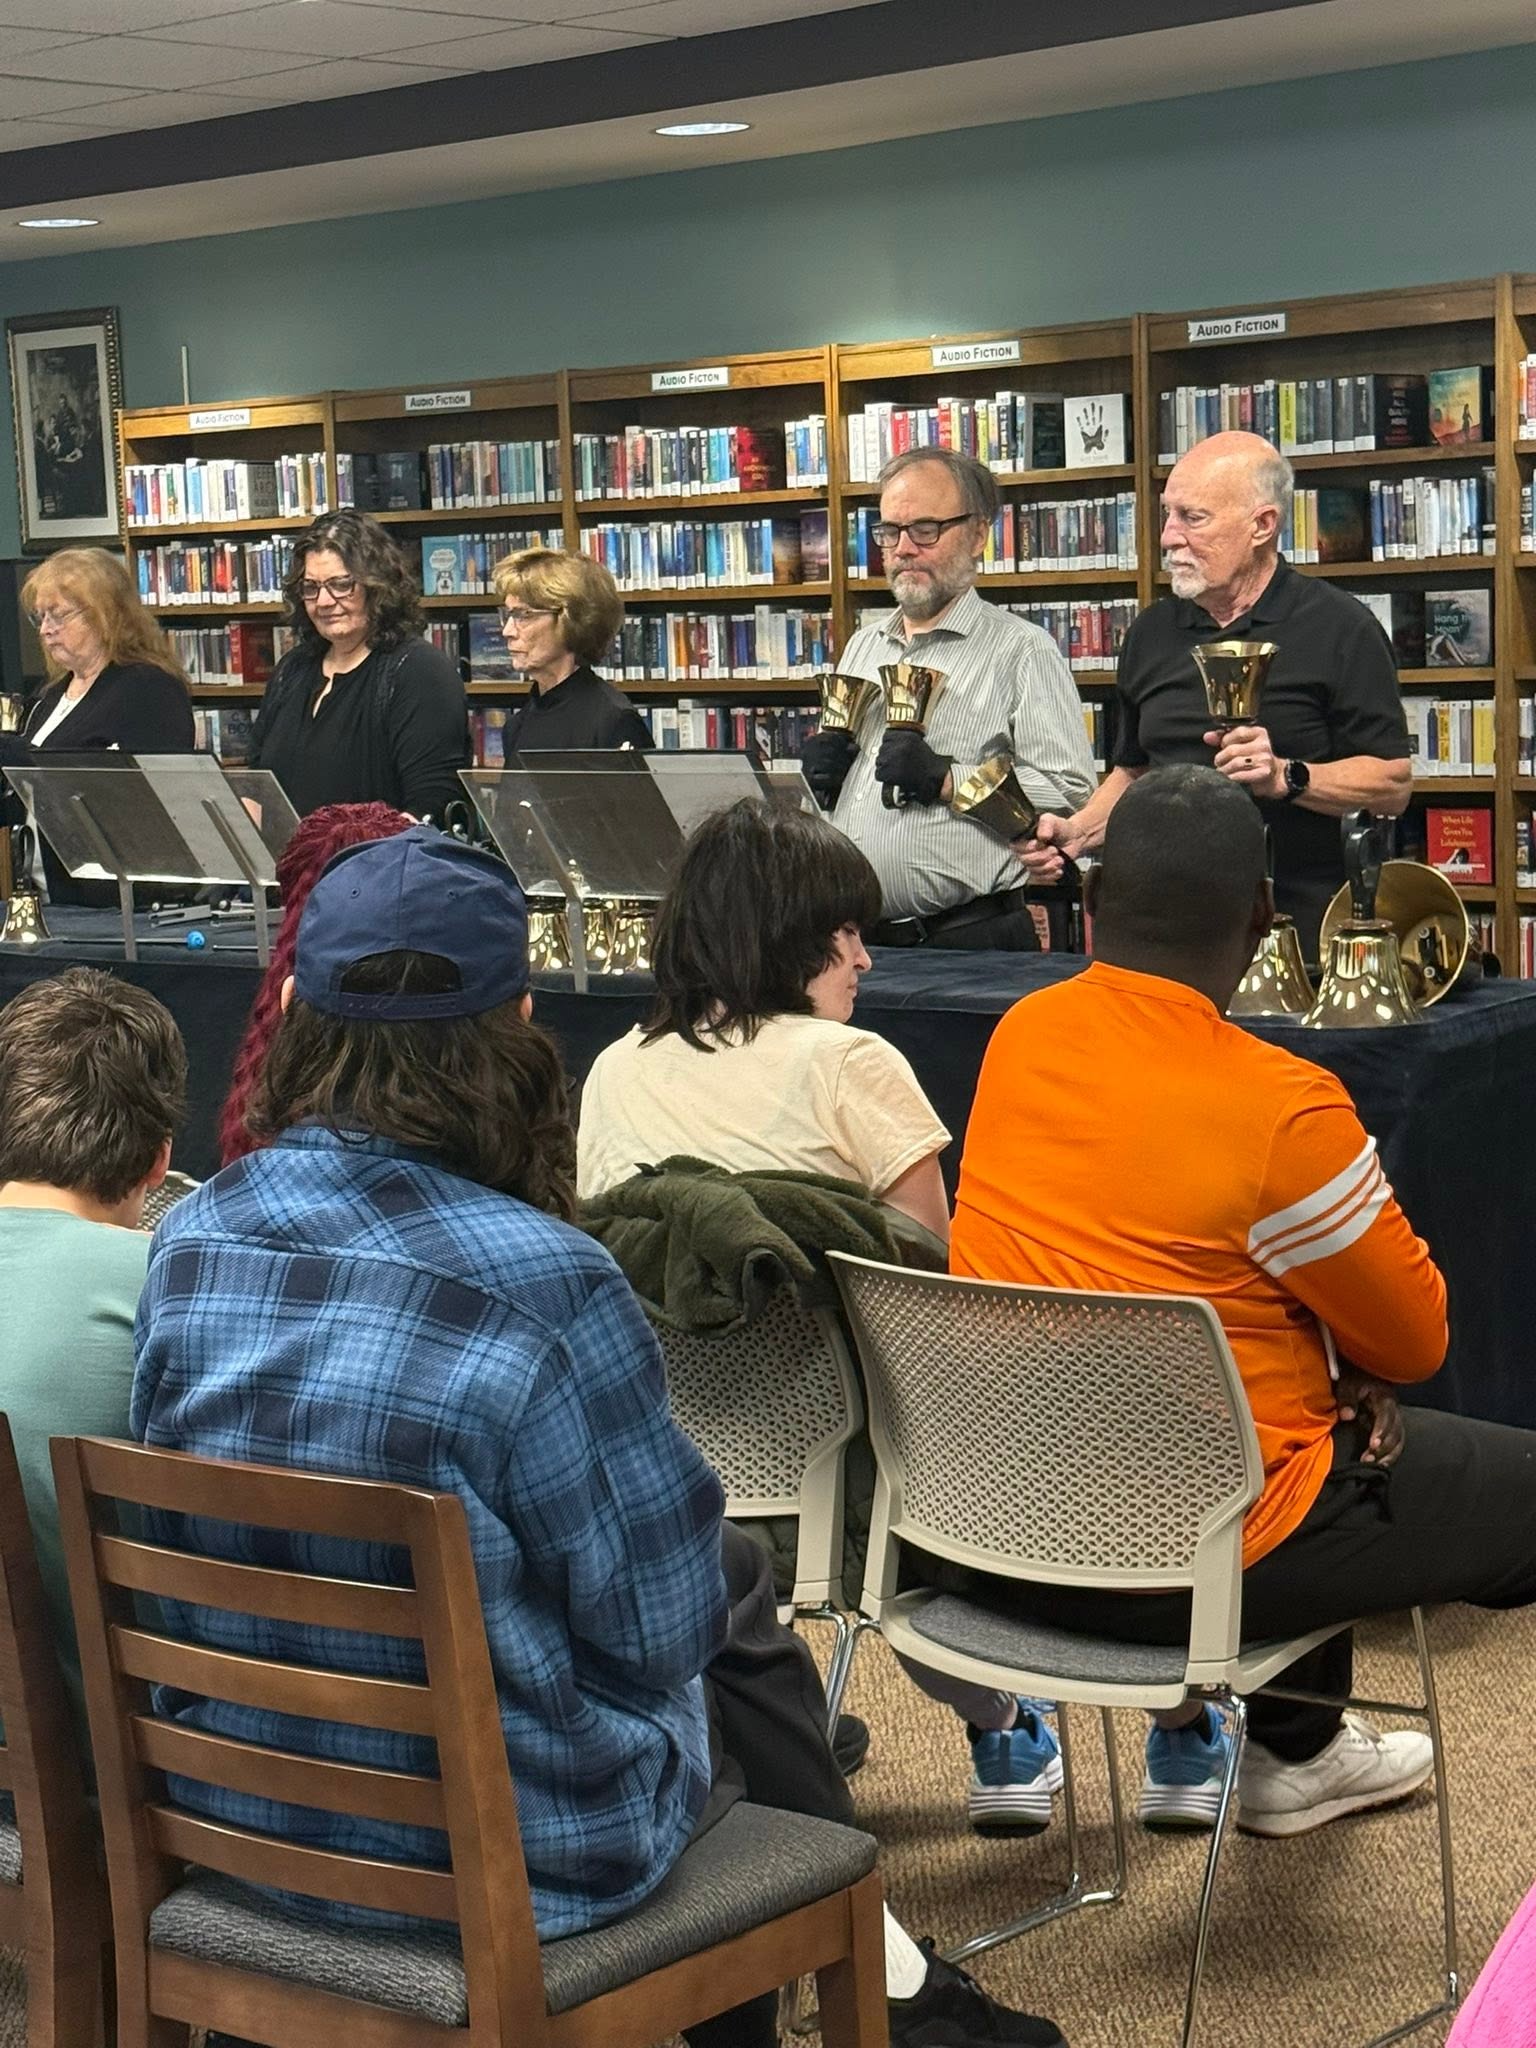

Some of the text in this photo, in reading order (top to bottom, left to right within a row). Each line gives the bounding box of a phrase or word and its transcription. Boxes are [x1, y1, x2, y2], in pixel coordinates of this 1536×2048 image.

[1197, 319, 1279, 336] AUDIO FICTION
[940, 346, 1012, 362] AUDIO FICTION
[660, 373, 720, 386] AUDIO FICTON
[436, 394, 467, 405] FICTION
